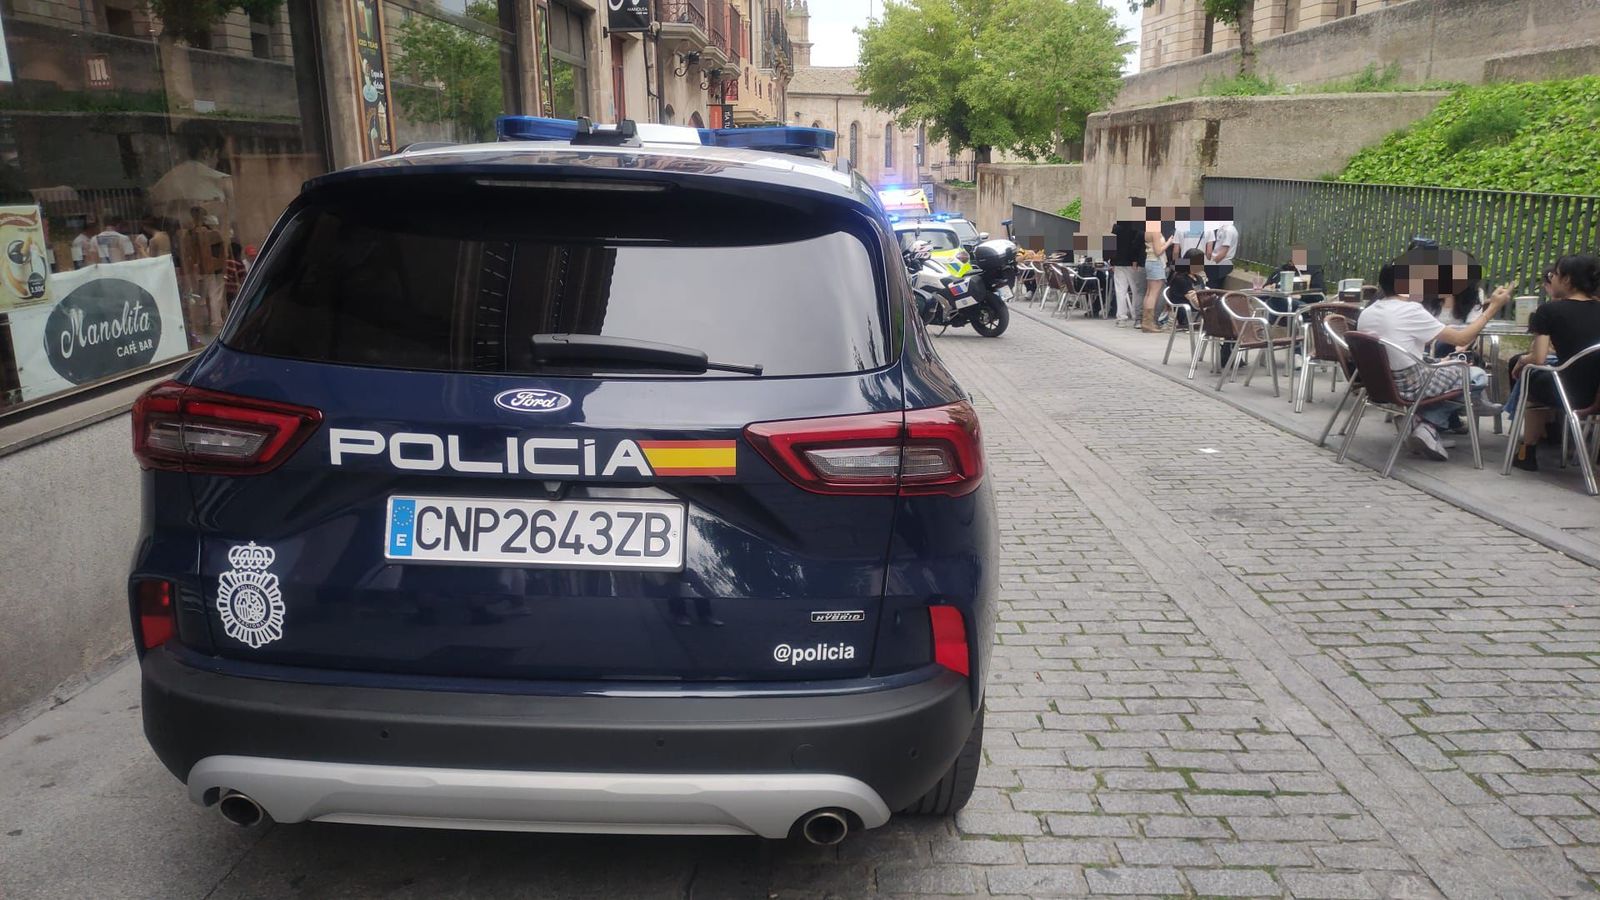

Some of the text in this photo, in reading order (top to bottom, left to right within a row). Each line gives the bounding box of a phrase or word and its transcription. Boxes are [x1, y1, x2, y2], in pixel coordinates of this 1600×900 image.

[61, 300, 151, 359] Manolita
[139, 338, 153, 352] BAR
[511, 390, 556, 410] Ford
[396, 533, 408, 547] E
[415, 505, 672, 558] CNP2643ZB
[816, 613, 861, 621] HYBRID
[773, 642, 855, 666] @policia
